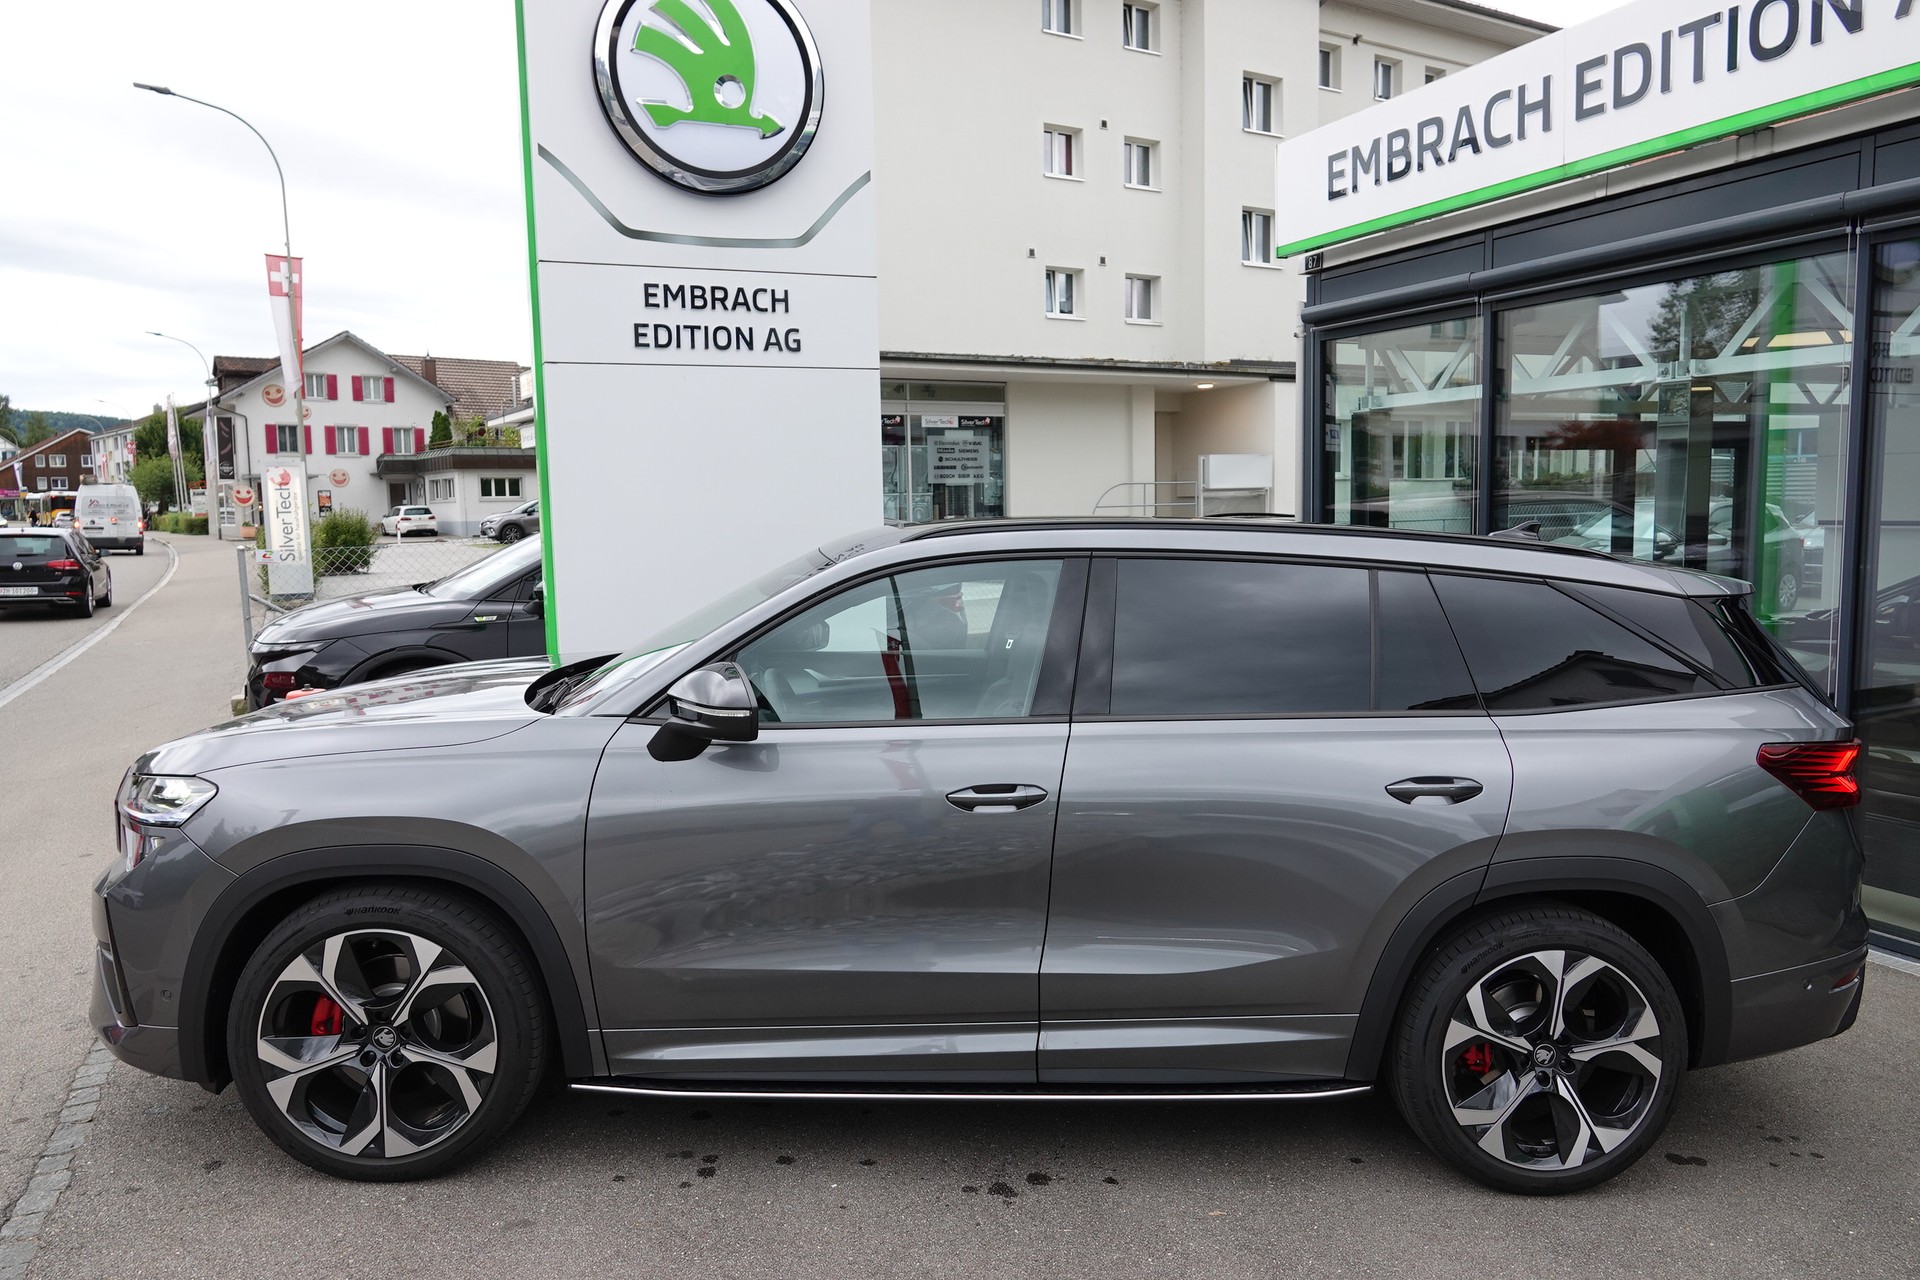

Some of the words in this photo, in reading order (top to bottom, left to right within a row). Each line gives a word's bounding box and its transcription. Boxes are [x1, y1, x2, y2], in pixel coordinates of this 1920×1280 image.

[1328, 74, 1553, 201] EMBRACH
[1575, 0, 1865, 122] EDITION
[1308, 256, 1318, 269] 87
[643, 282, 790, 314] EMBRACH
[633, 322, 755, 352] EDITION
[763, 327, 802, 353] AG
